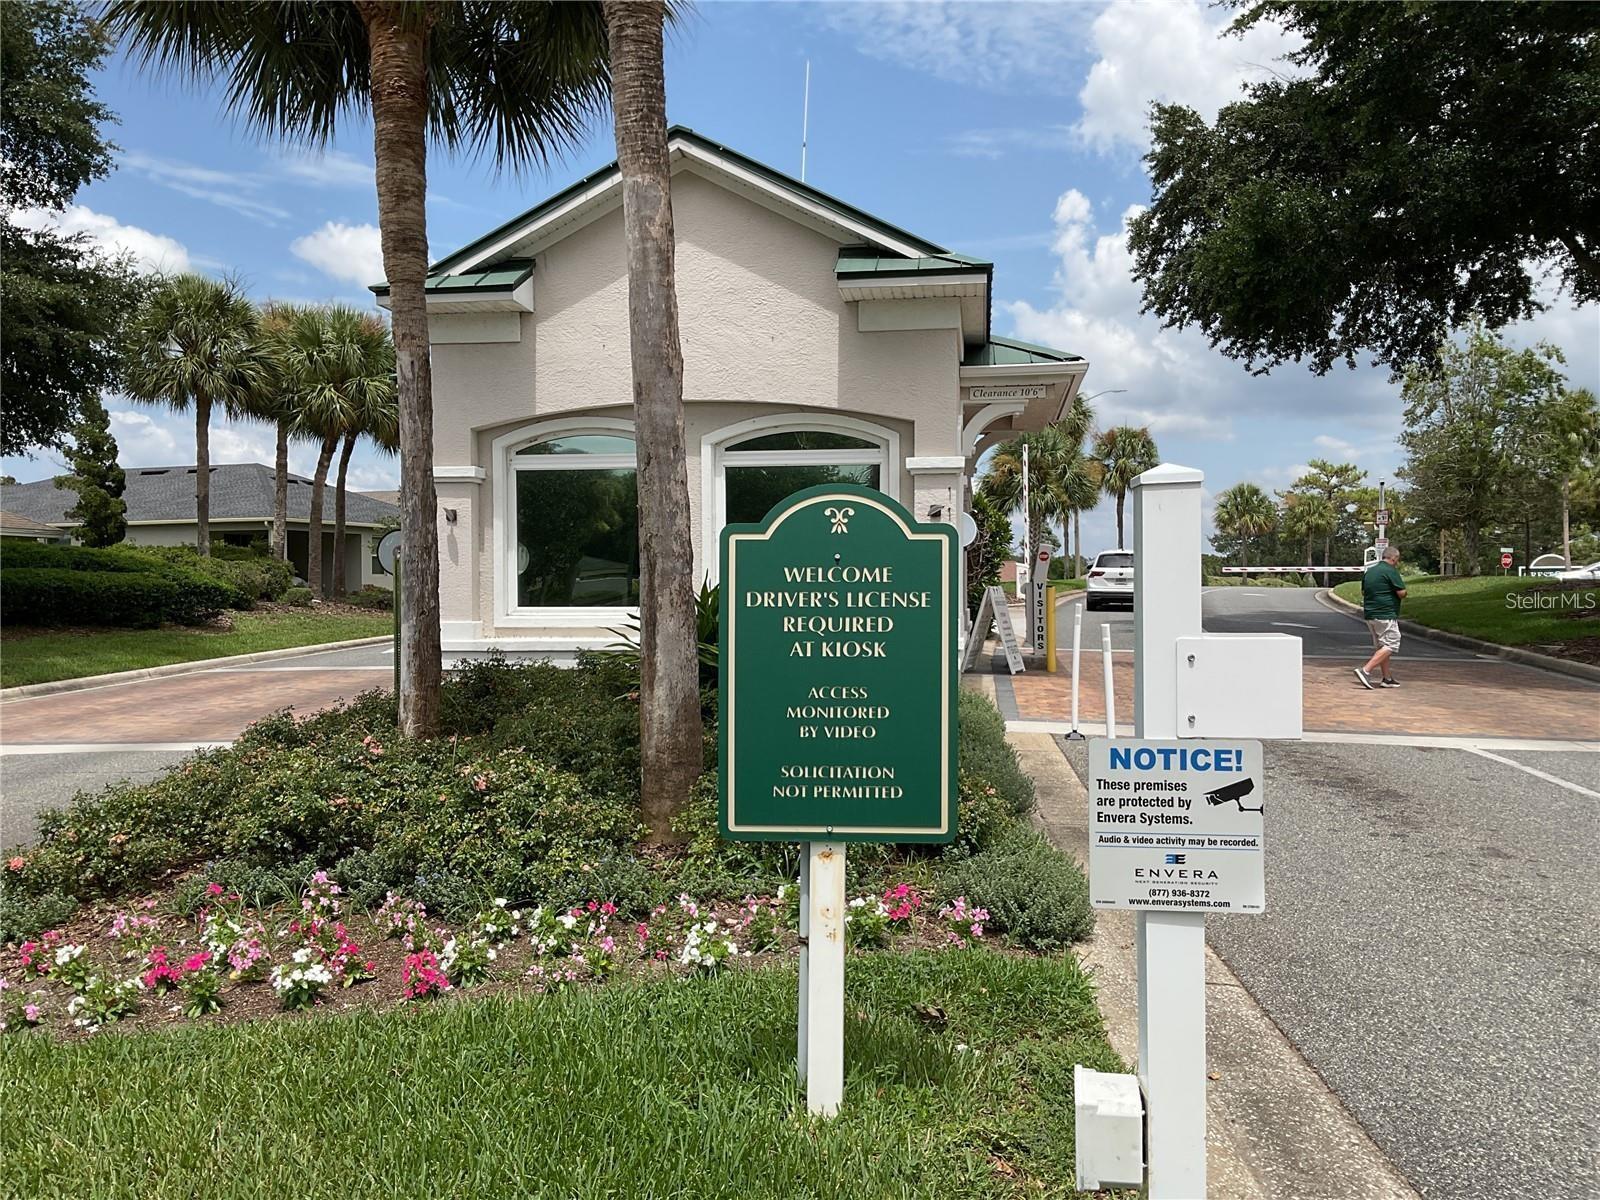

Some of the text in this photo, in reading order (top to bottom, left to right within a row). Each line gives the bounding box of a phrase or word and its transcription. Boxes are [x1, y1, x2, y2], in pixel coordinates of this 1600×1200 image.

[973, 389, 1017, 398] Clearance
[783, 566, 893, 583] WELCOME
[746, 591, 931, 608] DRIVER'S LICENSE
[1036, 583, 1044, 650] VISITORS
[783, 616, 894, 637] REQUIRED
[789, 641, 887, 658] AT KIOSK
[808, 686, 868, 699] ACCESS
[786, 706, 890, 719] MONITORED
[799, 725, 876, 739] BY VIDEO
[1110, 747, 1243, 772] NOTICE!
[781, 766, 894, 779] SOLICITATION
[773, 785, 903, 799] NOT PERMITTED
[1096, 779, 1188, 794] These premises
[1097, 796, 1192, 811] are protected by
[1097, 812, 1193, 826] Envera Systems.
[1098, 835, 1259, 847] Audio & video activity may be recorded.
[1135, 868, 1218, 879] ENVERA
[1149, 889, 1210, 898] (877) 936-8372
[1129, 898, 1231, 908] www.enverasystems.com
